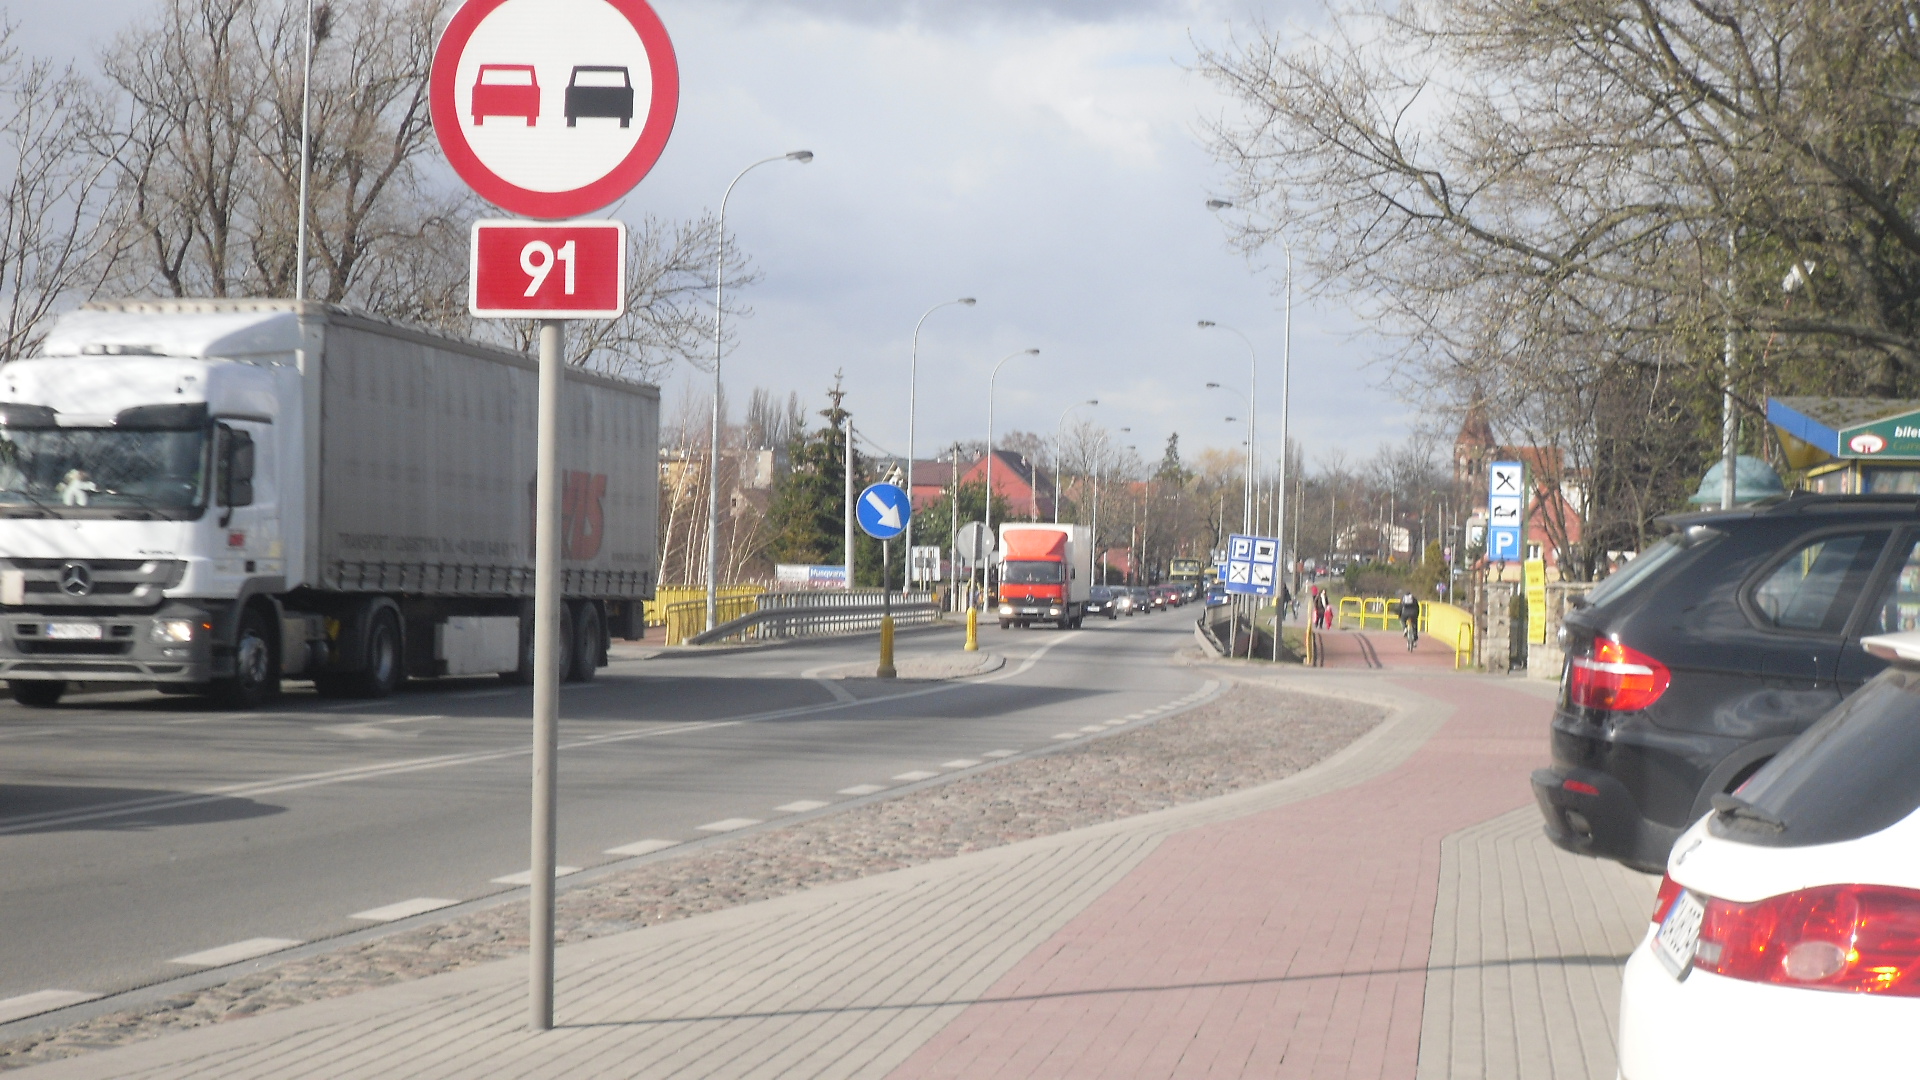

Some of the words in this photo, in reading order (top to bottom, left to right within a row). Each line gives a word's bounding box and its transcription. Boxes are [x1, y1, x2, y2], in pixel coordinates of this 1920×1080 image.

[520, 240, 576, 297] 91
[1234, 540, 1248, 558] P
[1496, 531, 1514, 554] P
